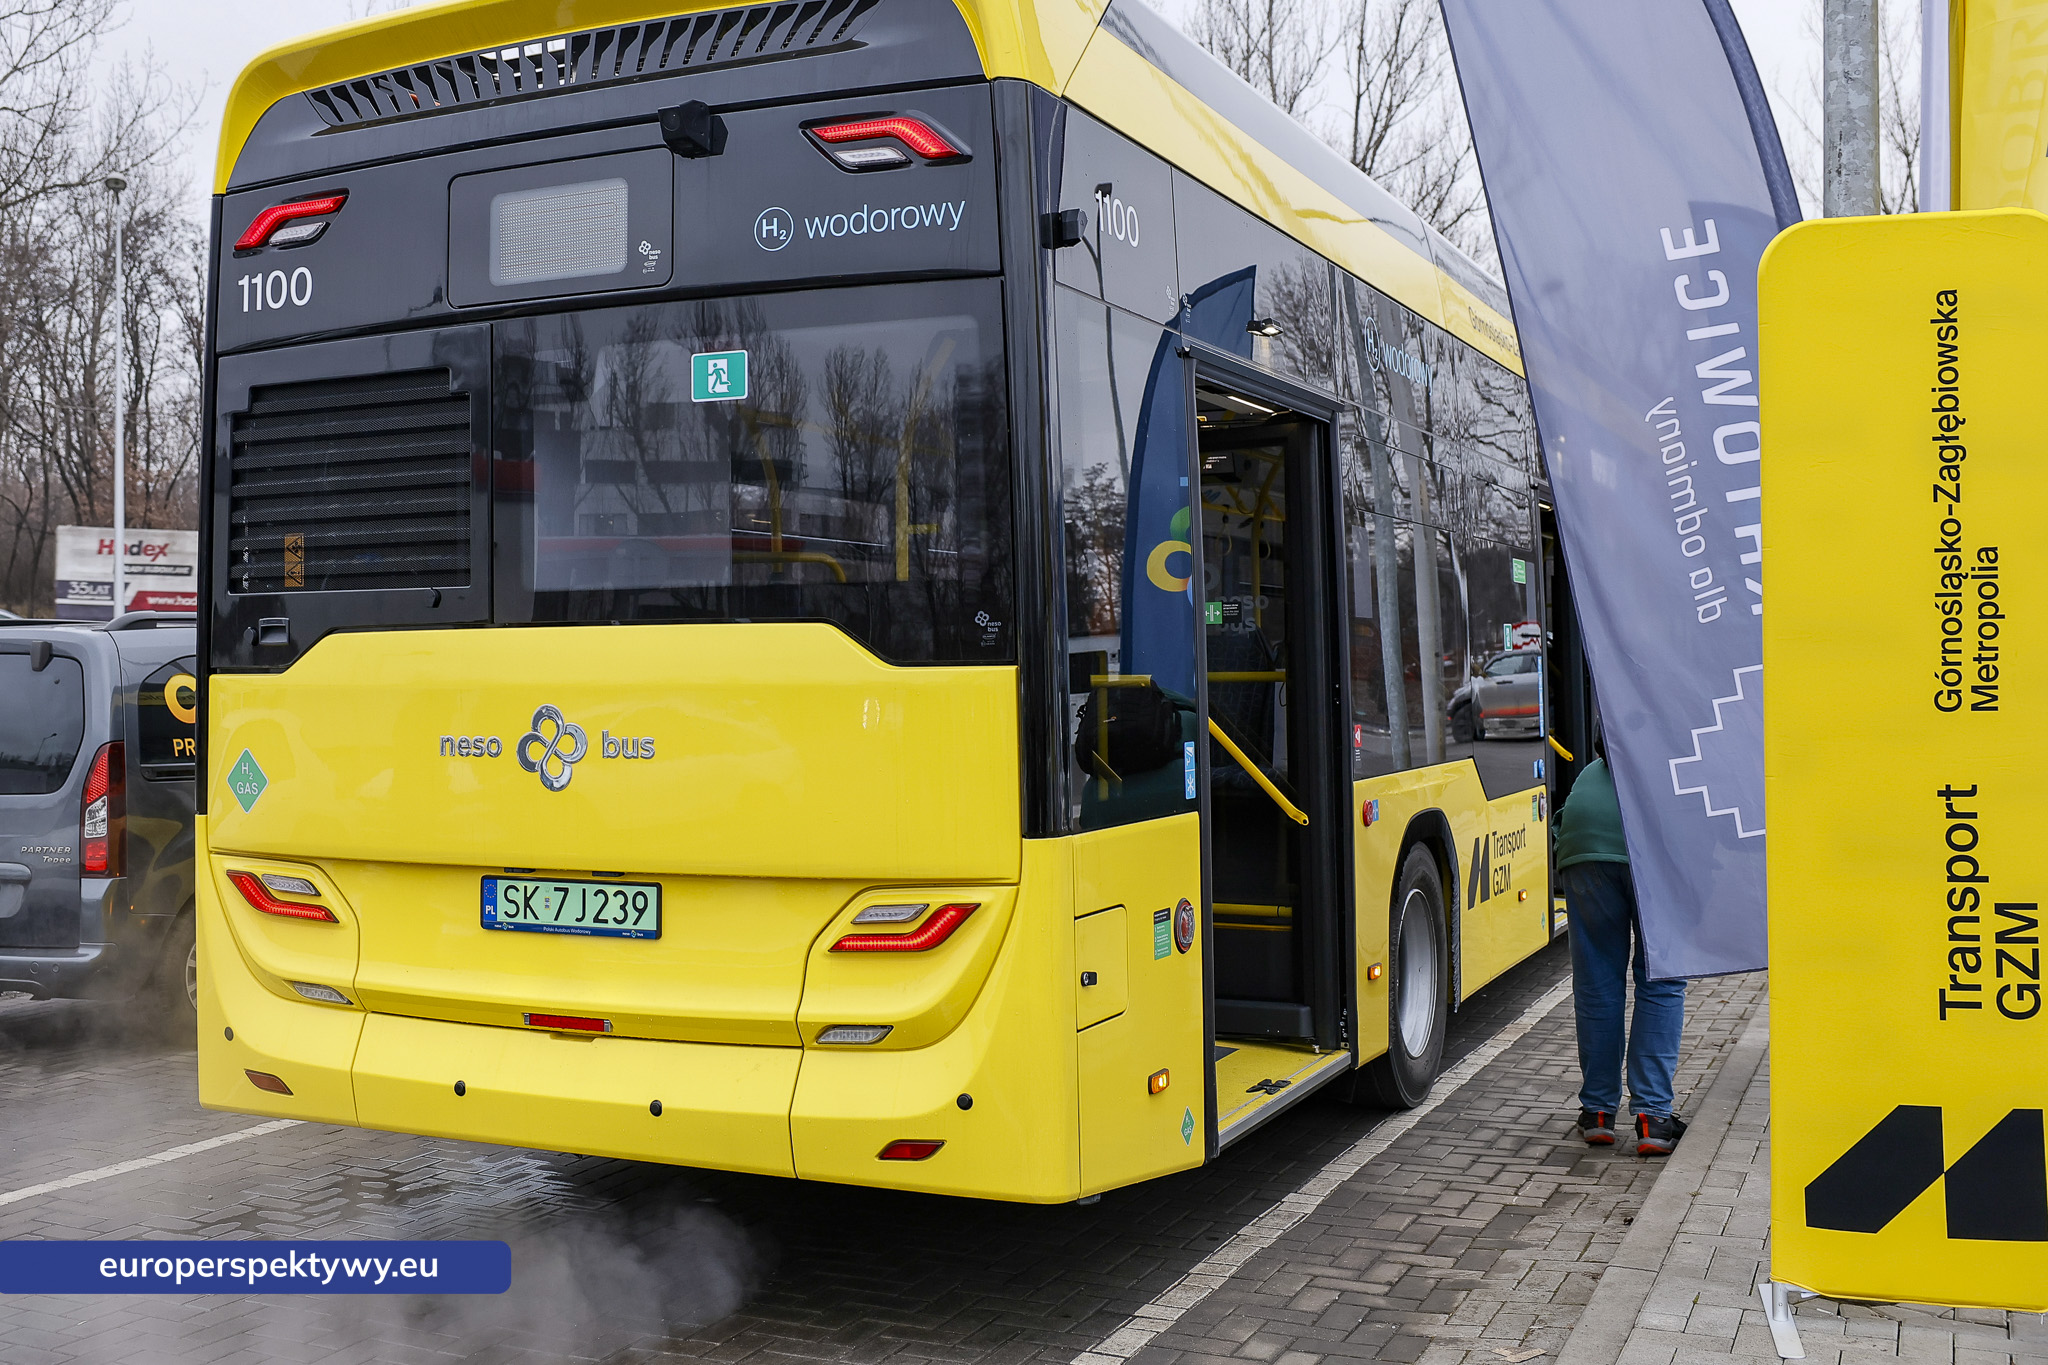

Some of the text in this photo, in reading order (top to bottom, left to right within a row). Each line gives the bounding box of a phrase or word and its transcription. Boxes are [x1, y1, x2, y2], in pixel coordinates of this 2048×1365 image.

[804, 200, 966, 240] wodorowy
[1094, 190, 1140, 248] 1100
[238, 267, 313, 313] 1100
[1381, 342, 1433, 396] wodorowy
[1930, 288, 1968, 713] Górnośląsko-Zagłębiowska
[97, 539, 170, 562] Hdex
[1970, 545, 2006, 712] Metropolia
[173, 738, 196, 757] PR
[439, 730, 656, 759] neso bus
[236, 781, 259, 796] GAS
[21, 846, 71, 854] PARTNER
[42, 855, 71, 863] Tepee
[1491, 823, 1527, 859] Transport
[1492, 863, 1512, 897] GZM
[485, 884, 649, 926] PL SK 7J239
[1937, 783, 1990, 1021] Transport
[1993, 901, 2042, 1021] GZM
